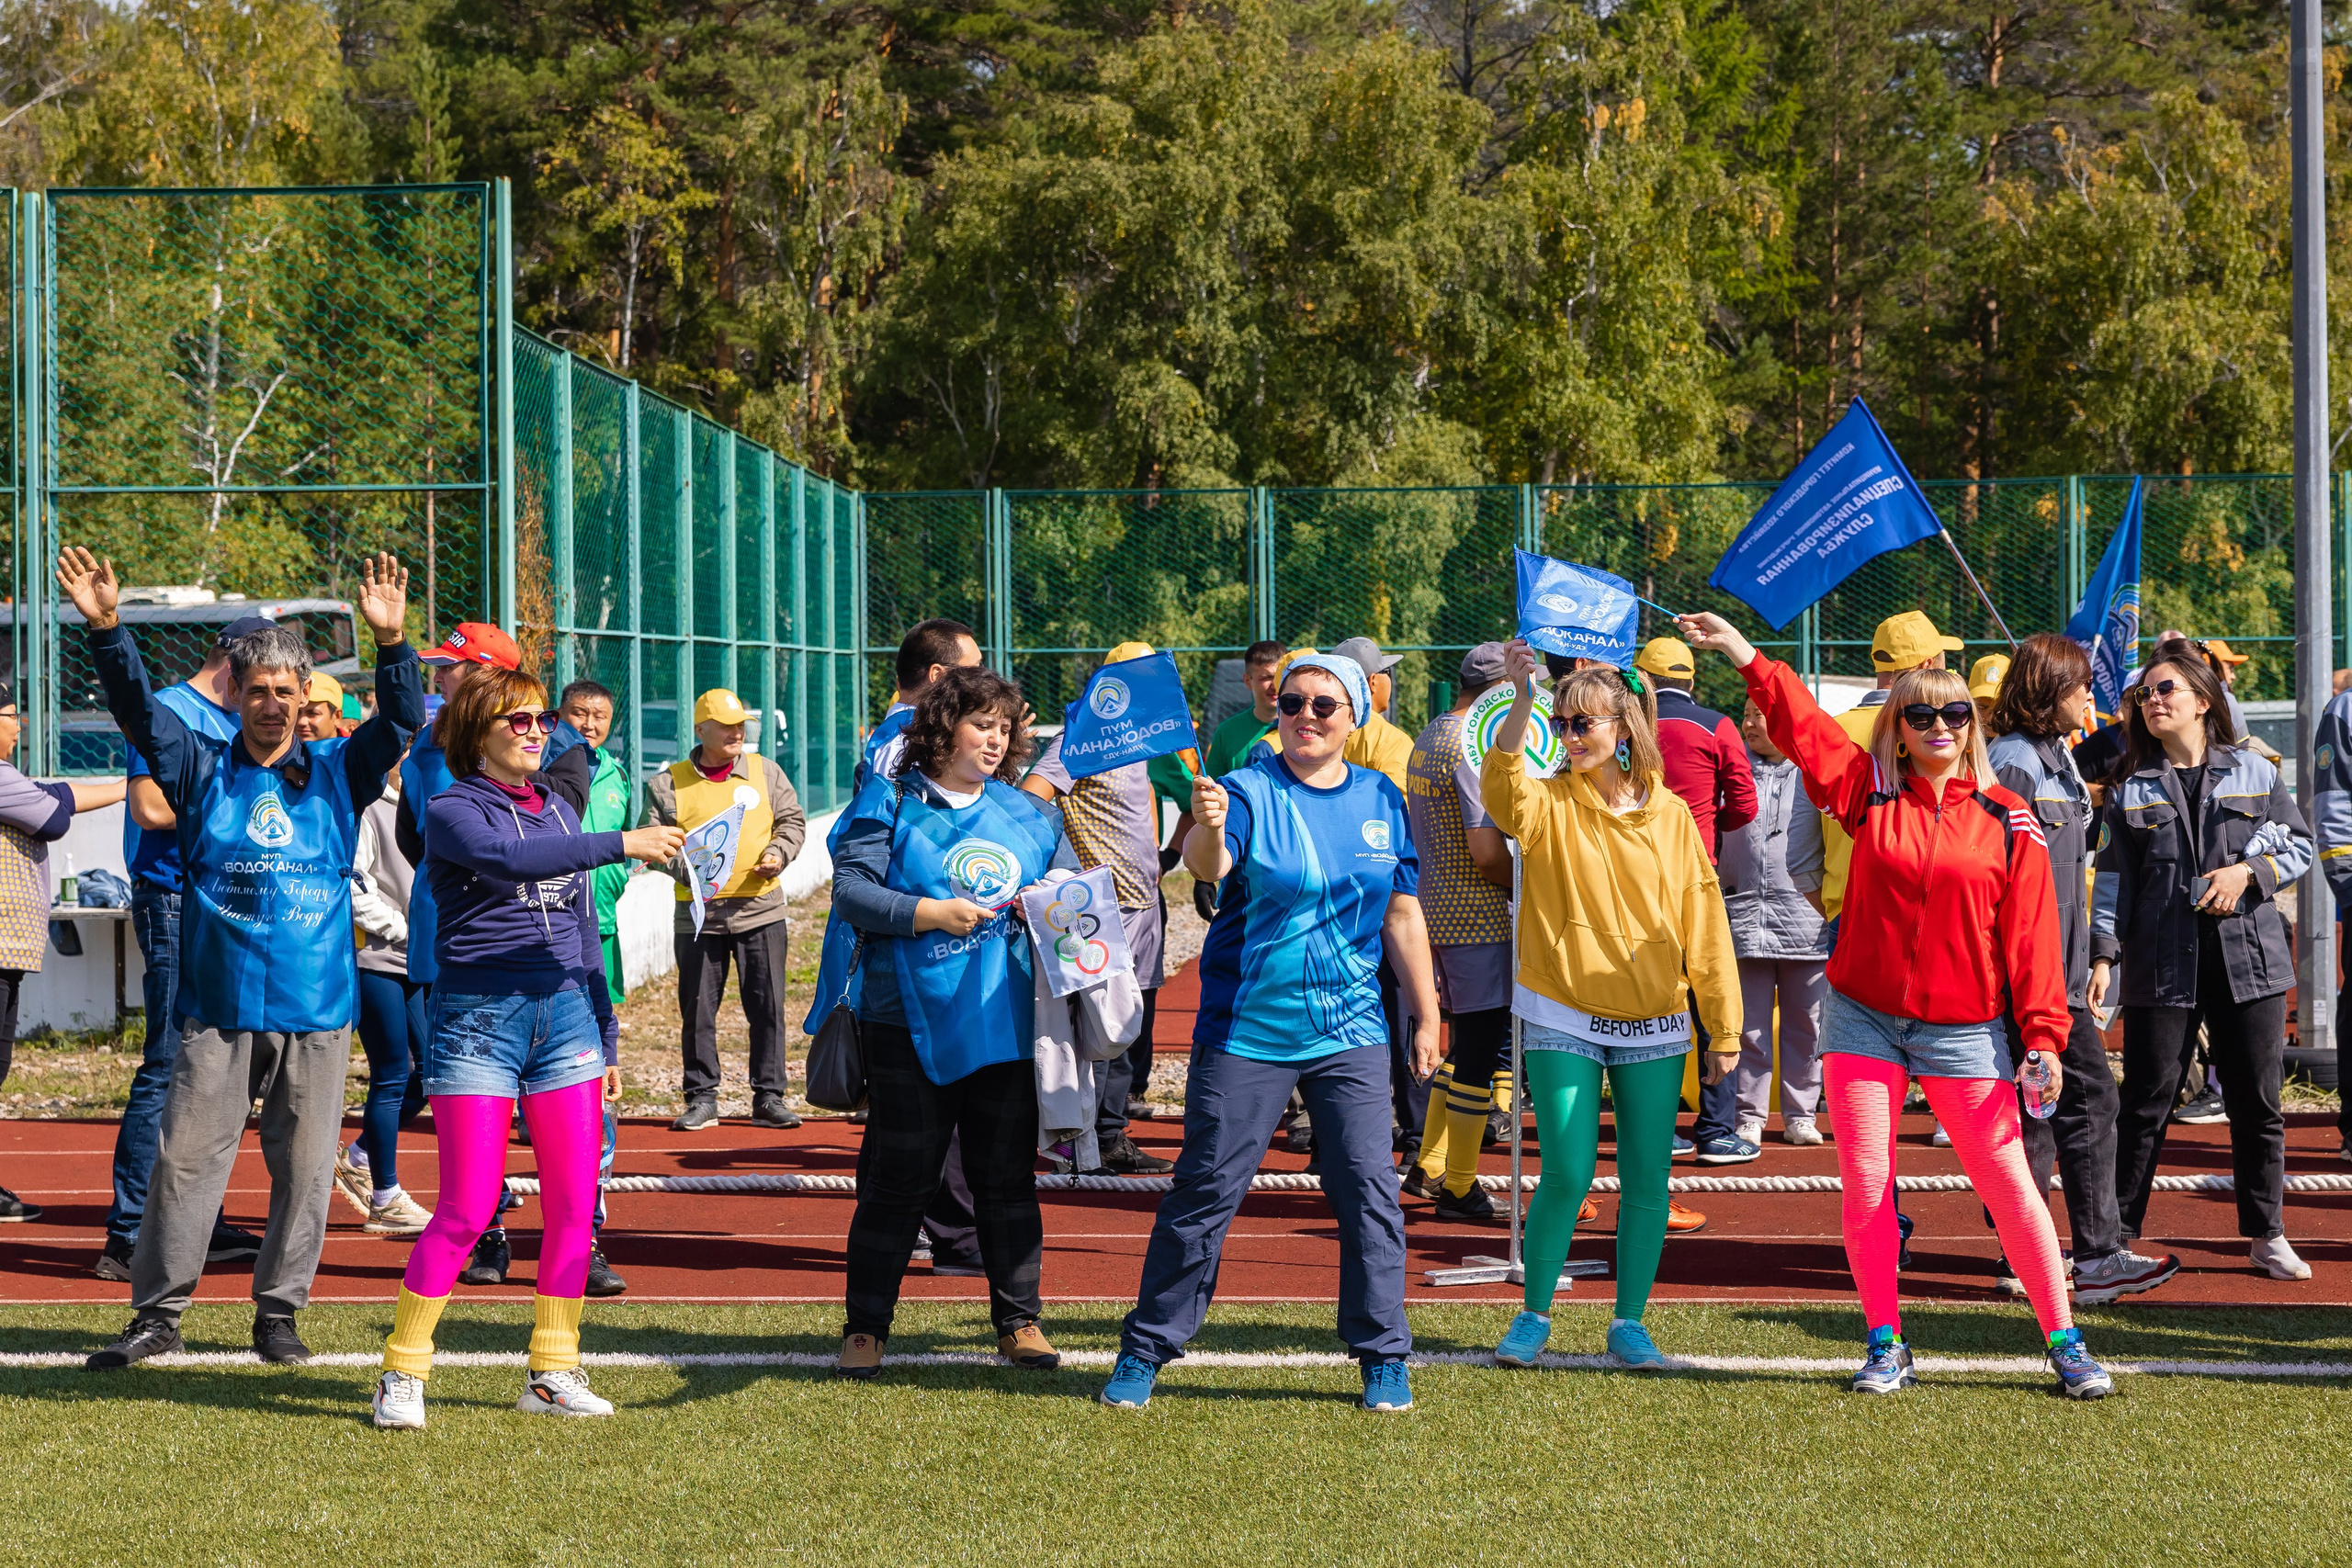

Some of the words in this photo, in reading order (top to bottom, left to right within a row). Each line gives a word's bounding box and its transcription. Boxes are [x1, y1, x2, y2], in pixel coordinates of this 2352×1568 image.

[1466, 688, 1515, 740] «ГОРОДСКО
[1466, 743, 1481, 767] МБУ
[220, 861, 318, 874] «ВОДОКАНАЛ»
[283, 878, 329, 901] Городу
[516, 882, 529, 903] YEAR
[543, 891, 560, 903] 972
[281, 904, 331, 928] Воду!
[1589, 1015, 1655, 1037] BEFORE
[1658, 1014, 1685, 1033] DAY
